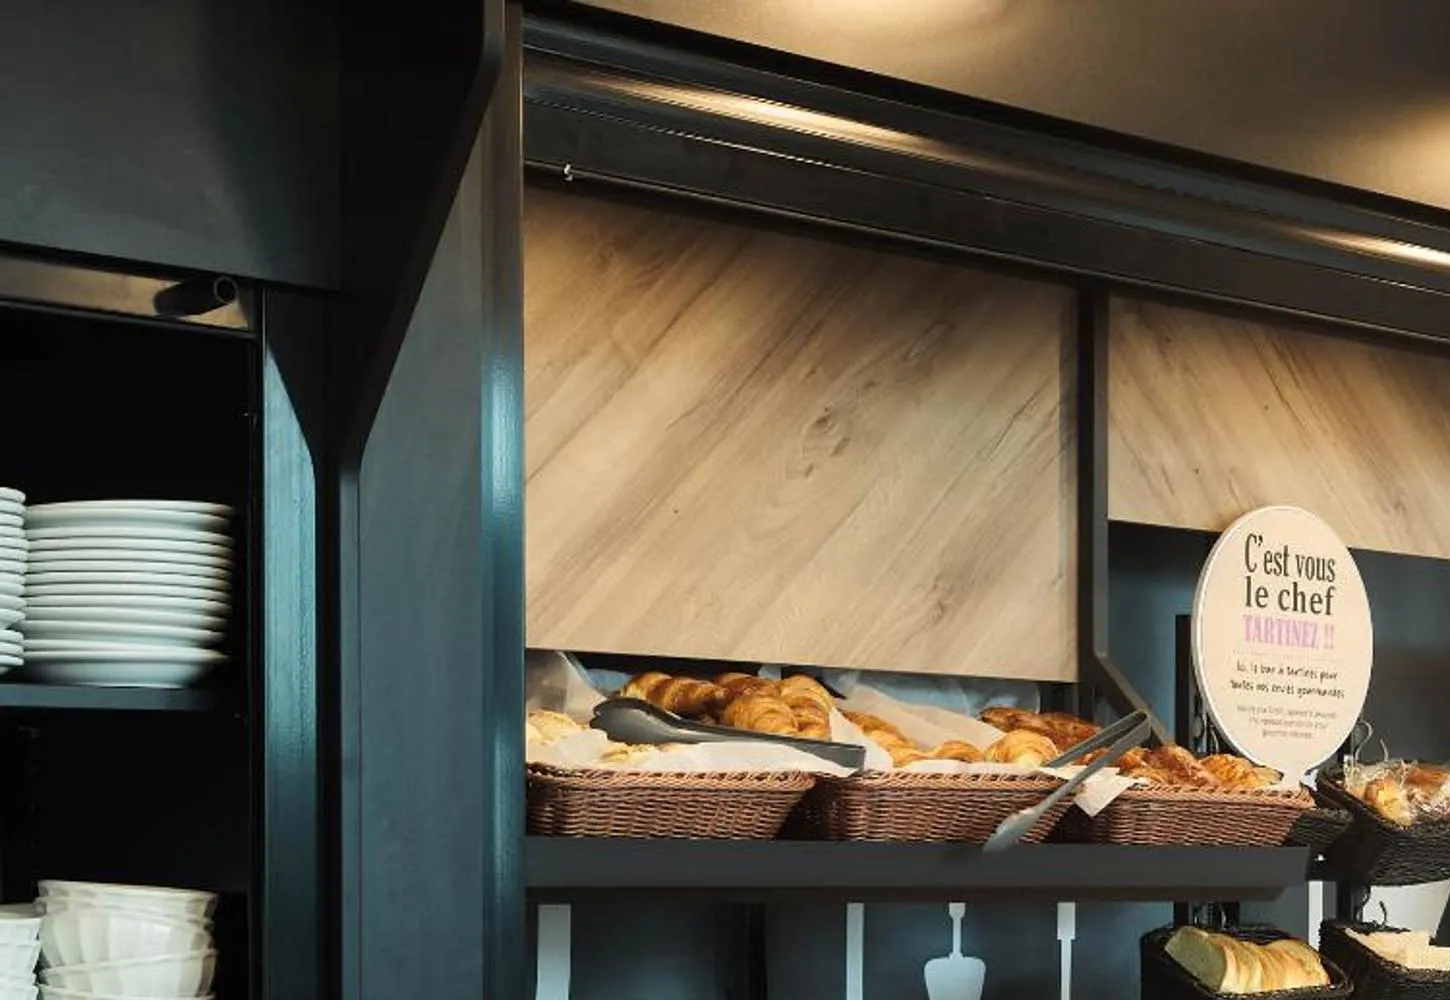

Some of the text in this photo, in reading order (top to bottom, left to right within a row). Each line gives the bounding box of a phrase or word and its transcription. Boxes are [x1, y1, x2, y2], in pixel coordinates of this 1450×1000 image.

[1244, 532, 1336, 583] C'est vous
[1244, 575, 1337, 615] le chef
[1243, 614, 1319, 650] TARTINEZ
